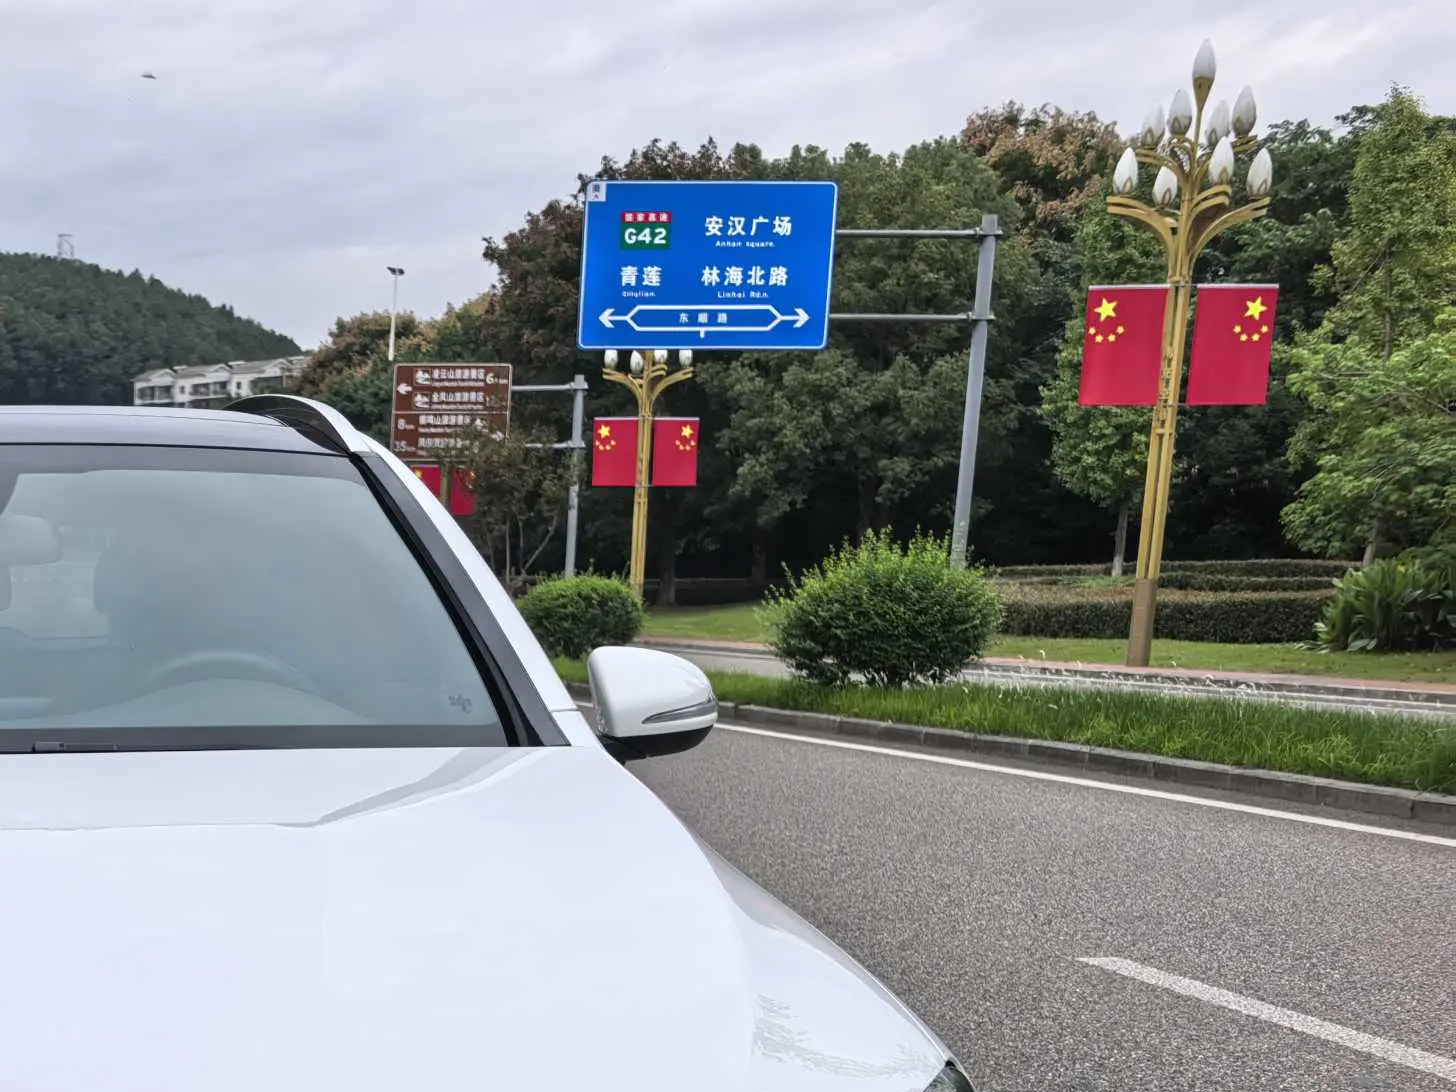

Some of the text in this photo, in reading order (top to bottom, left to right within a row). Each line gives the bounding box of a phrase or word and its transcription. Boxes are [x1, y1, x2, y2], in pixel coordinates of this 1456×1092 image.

[624, 228, 667, 244] G42
[705, 216, 792, 236] 安汉广场
[620, 265, 662, 287] 青莲
[701, 266, 788, 287] 林海北路
